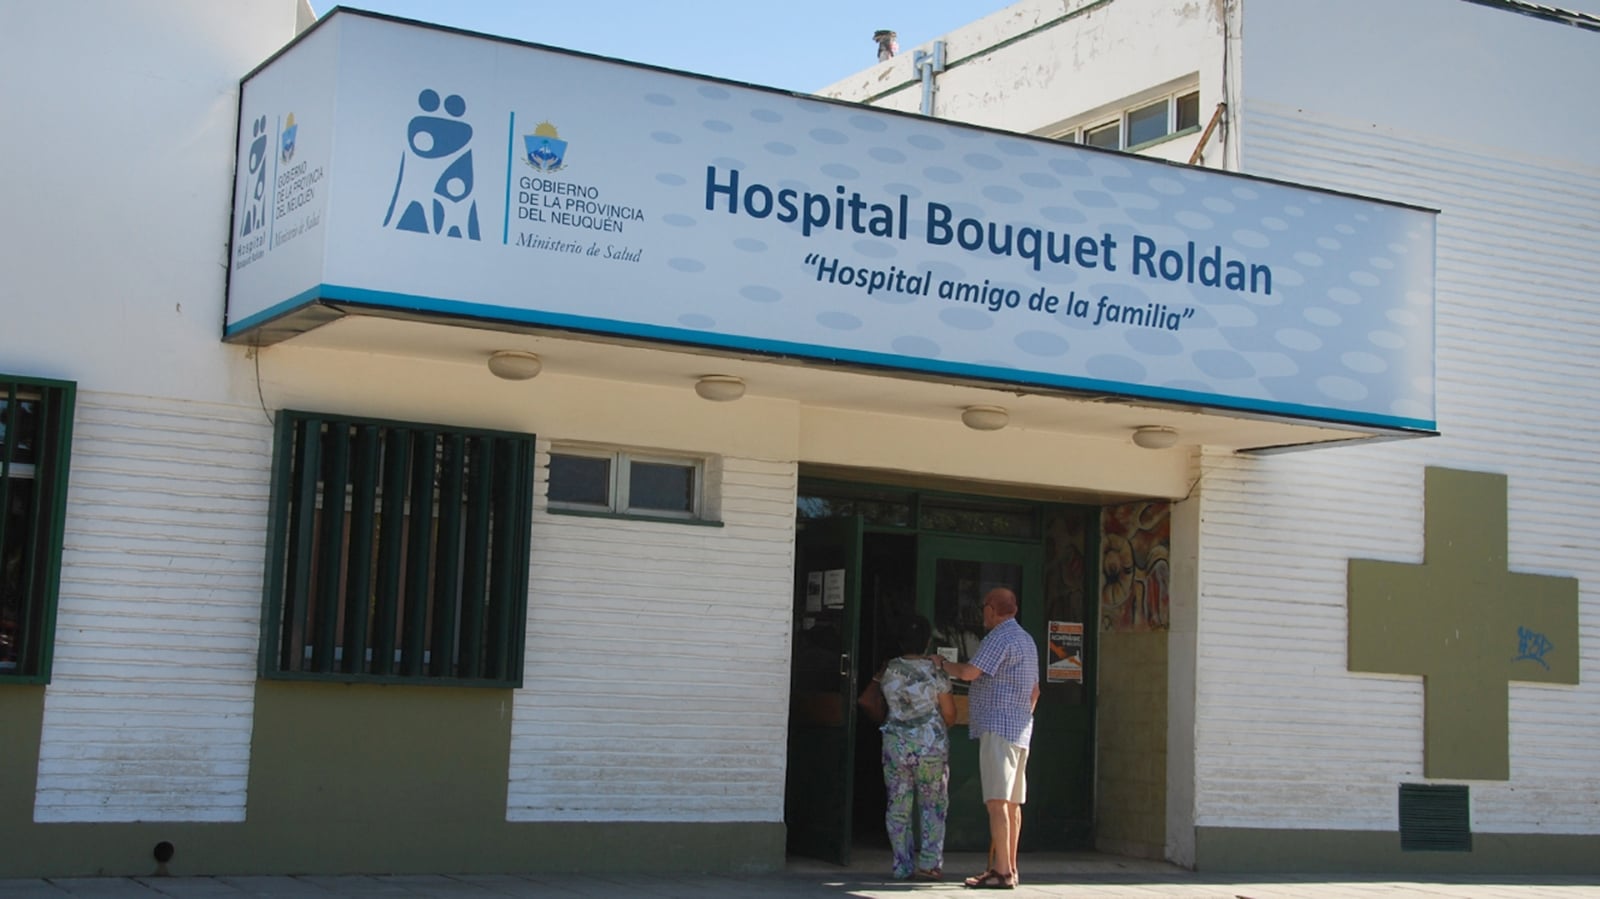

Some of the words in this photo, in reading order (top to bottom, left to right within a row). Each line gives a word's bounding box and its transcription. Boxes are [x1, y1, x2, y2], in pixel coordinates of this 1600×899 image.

[519, 176, 599, 200] GOBIERNO
[518, 191, 539, 206] DE
[543, 195, 562, 209] LA
[565, 198, 645, 222] PROVINCIA
[518, 206, 547, 222] DEL
[551, 211, 623, 233] NEUQUÉN
[236, 231, 266, 257] Hospital
[705, 165, 908, 240] Hospital
[926, 201, 1117, 271] Bouquet
[1132, 234, 1272, 296] Roldan
[515, 232, 583, 254] Ministerio
[586, 242, 601, 257] de
[603, 244, 643, 263] Salud
[804, 253, 932, 296] “Hospital
[938, 279, 1021, 312] amigo
[1028, 287, 1060, 314] de
[1066, 291, 1090, 319] la
[1093, 295, 1195, 332] familia”
